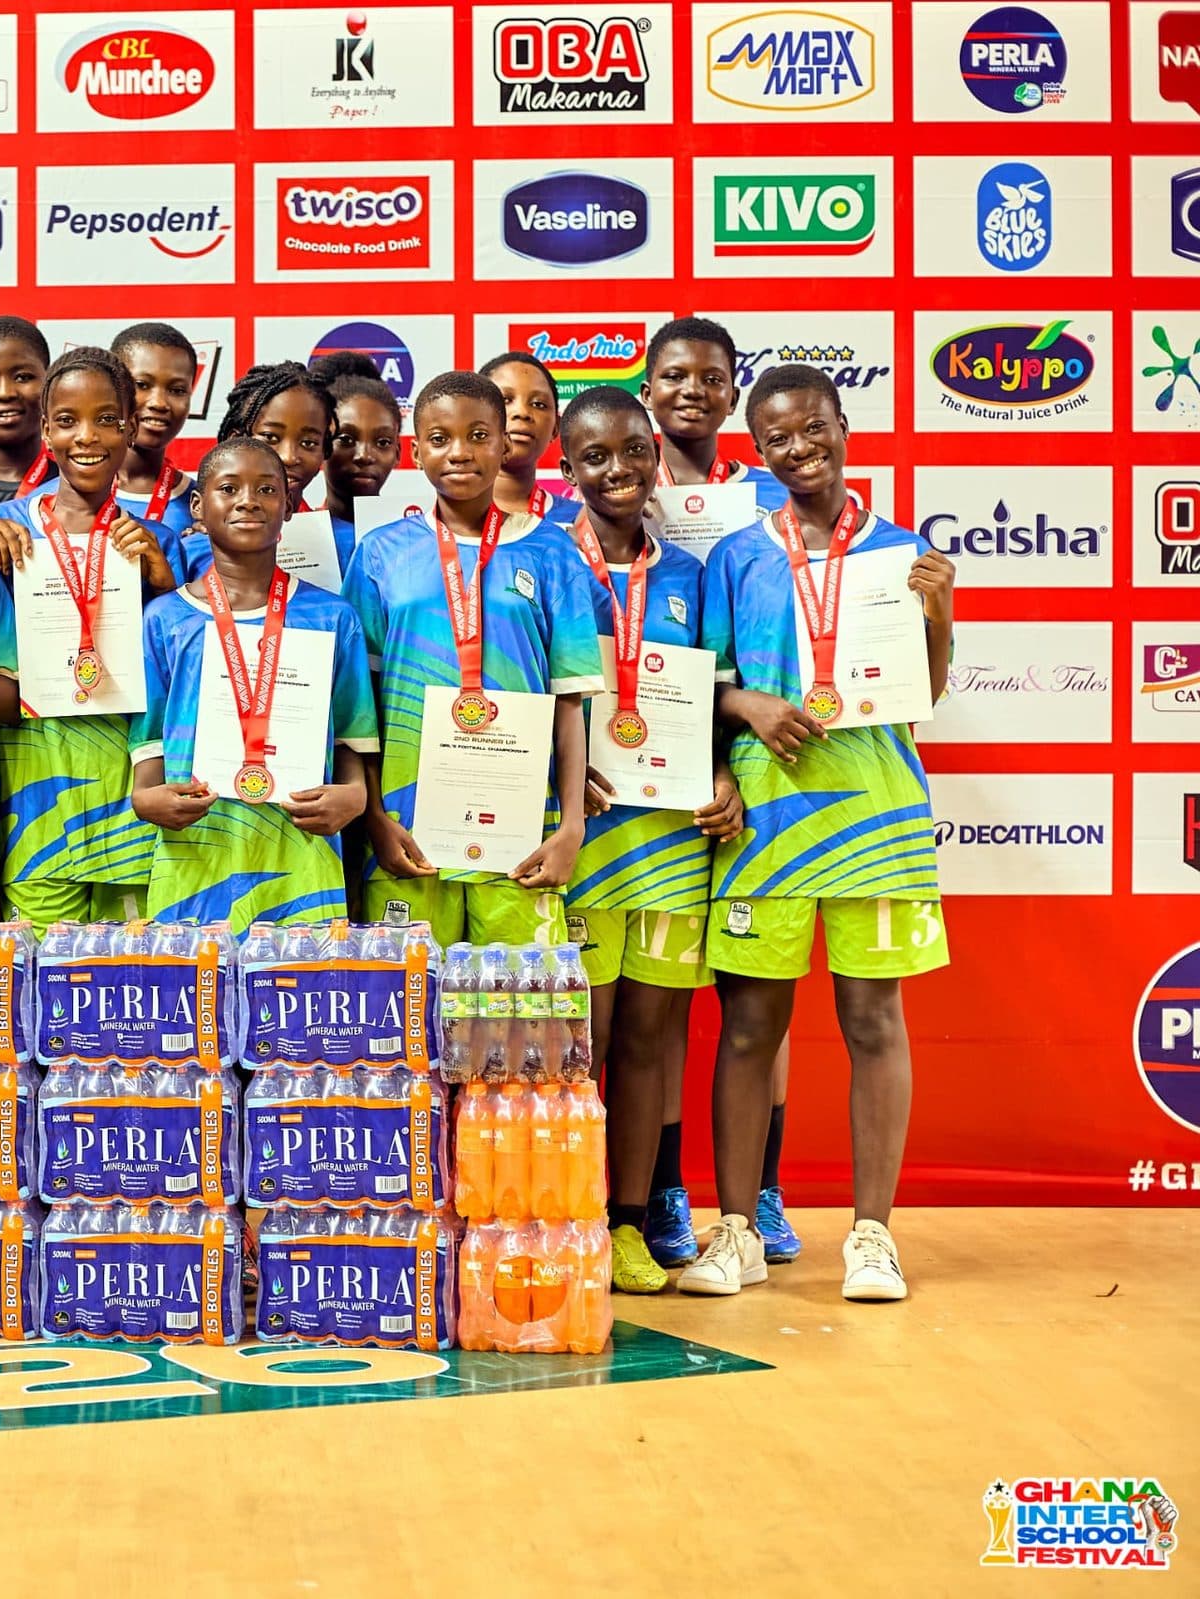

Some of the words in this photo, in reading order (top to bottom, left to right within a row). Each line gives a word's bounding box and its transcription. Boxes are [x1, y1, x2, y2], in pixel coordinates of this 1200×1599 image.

[102, 38, 154, 60] CBL
[500, 24, 644, 79] OBA
[972, 43, 1055, 67] PERLA
[1162, 45, 1200, 67] NA
[76, 59, 202, 97] Munchee
[506, 84, 639, 112] Makarna
[291, 188, 416, 222] twisco
[514, 203, 637, 230] Vaseline
[724, 185, 865, 232] KIVO
[46, 203, 221, 239] Pepsodent
[285, 237, 349, 254] Chocolate
[353, 239, 384, 253] Food
[387, 236, 421, 252] Drink
[950, 342, 1084, 391] Kalyppo
[940, 393, 963, 412] The
[964, 404, 1013, 420] Natural
[1017, 404, 1051, 420] Juice
[1053, 393, 1090, 415] Drink
[919, 500, 1100, 557] Geisha
[954, 664, 1022, 692] Treats
[959, 825, 1104, 844] DECATHLON
[865, 899, 941, 953] 13
[71, 985, 195, 1025] PERLA
[201, 969, 213, 1035] BOTTLES
[277, 990, 404, 1029] PERLA
[409, 973, 422, 1038] BOTTLES
[100, 1022, 131, 1030] MINERAL
[132, 1022, 156, 1031] WATER
[306, 1027, 337, 1037] MINERAL
[338, 1027, 363, 1036] WATER
[0, 1035, 10, 1050] 15
[202, 1040, 214, 1055] 15
[411, 1043, 423, 1057] 15
[0, 1100, 13, 1165] BOTTLES
[74, 1126, 200, 1165] PERLA
[205, 1110, 217, 1175] BOTTLES
[281, 1127, 410, 1166] PERLA
[415, 1110, 428, 1176] BOTTLES
[2, 1170, 13, 1185] 15
[103, 1163, 135, 1172] MINERAL
[135, 1164, 160, 1173] WATER
[311, 1162, 343, 1173] MINERAL
[344, 1162, 368, 1172] WATER
[206, 1180, 218, 1193] 15
[416, 1181, 428, 1197] 15
[267, 1252, 288, 1260] 500ML
[6, 1244, 18, 1308] BOTTLES
[76, 1263, 201, 1303] PERLA
[207, 1248, 220, 1313] BOTTLES
[290, 1265, 415, 1307] PERLA
[420, 1250, 433, 1317] BOTTLES
[104, 1297, 136, 1309] MINERAL
[137, 1297, 161, 1308] WATER
[318, 1301, 349, 1311] MINERAL
[351, 1301, 375, 1311] WATER
[7, 1313, 18, 1328] 15
[207, 1319, 219, 1335] 15
[420, 1322, 432, 1338] 15
